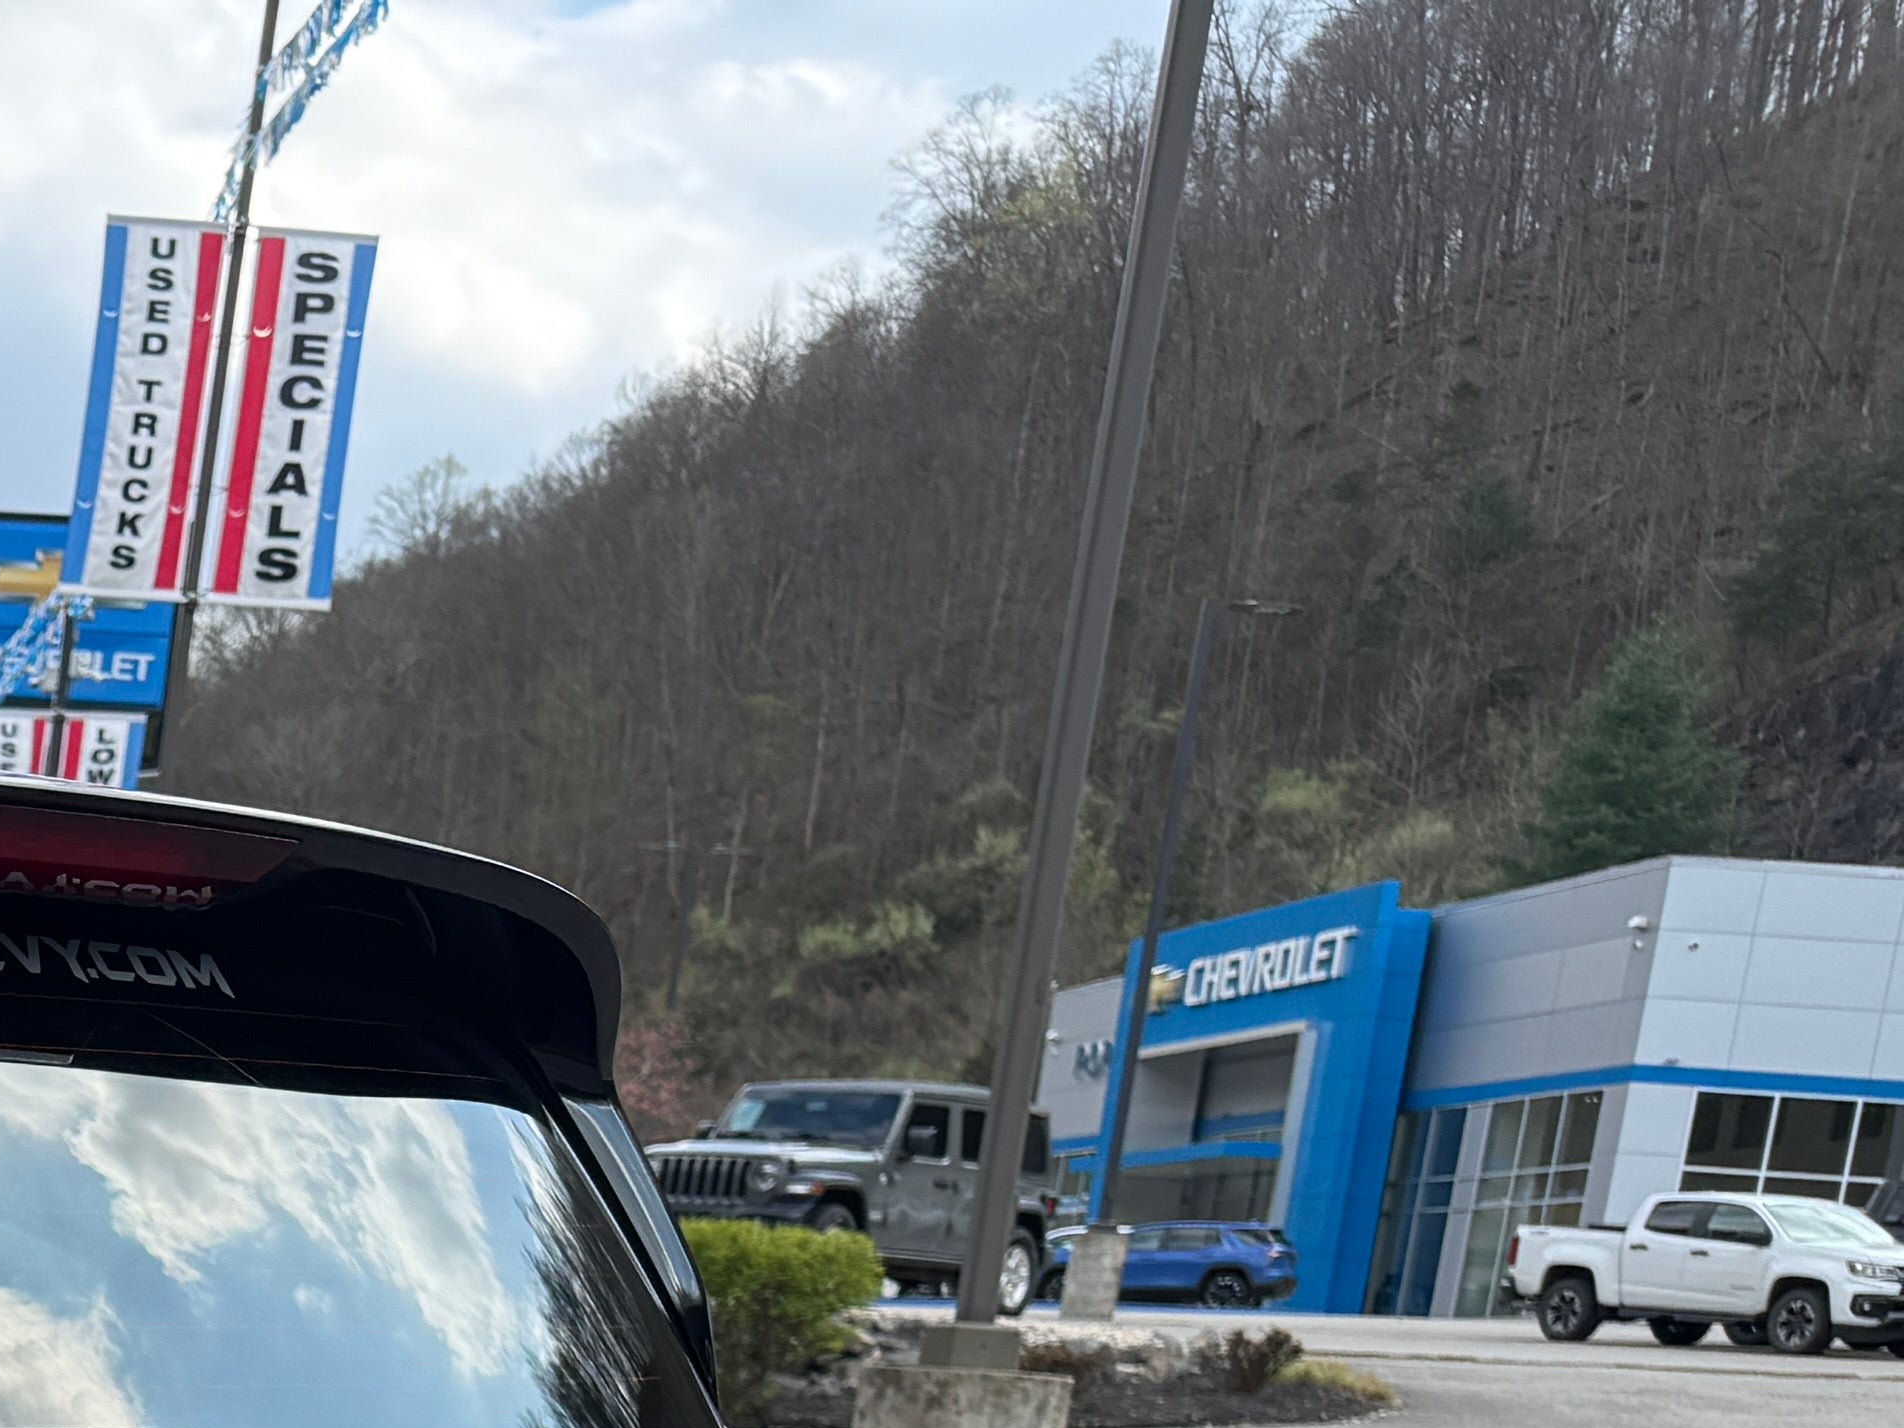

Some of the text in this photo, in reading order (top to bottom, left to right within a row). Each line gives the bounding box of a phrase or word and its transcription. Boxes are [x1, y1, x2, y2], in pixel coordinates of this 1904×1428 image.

[109, 236, 177, 571] USED TRUCKS
[254, 252, 339, 583] SPECIALS
[1183, 925, 1359, 1006] CHEVROLET
